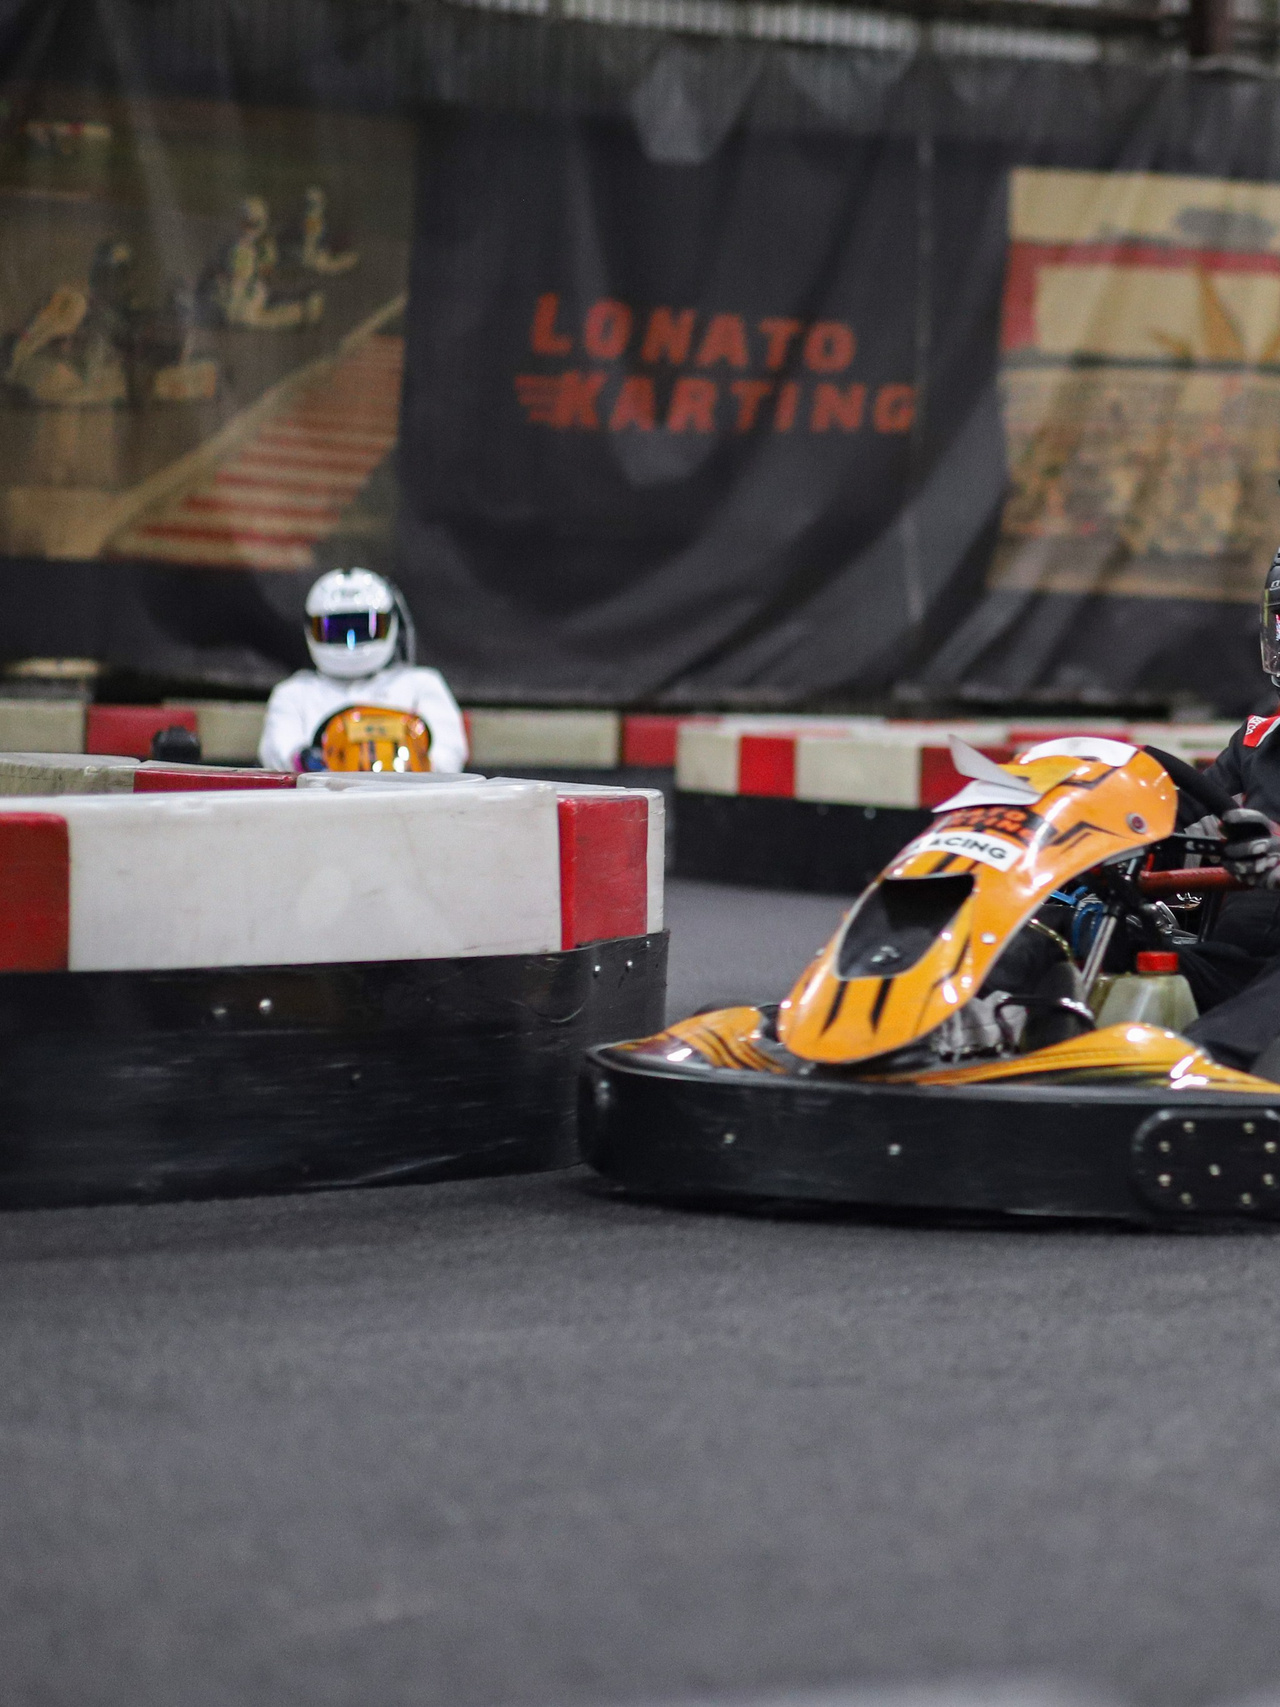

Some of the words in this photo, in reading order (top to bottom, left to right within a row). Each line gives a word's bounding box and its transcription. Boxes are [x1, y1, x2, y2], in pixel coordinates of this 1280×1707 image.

[530, 292, 857, 373] LONATO
[540, 369, 918, 433] KARTING
[913, 836, 1007, 860] ACING
